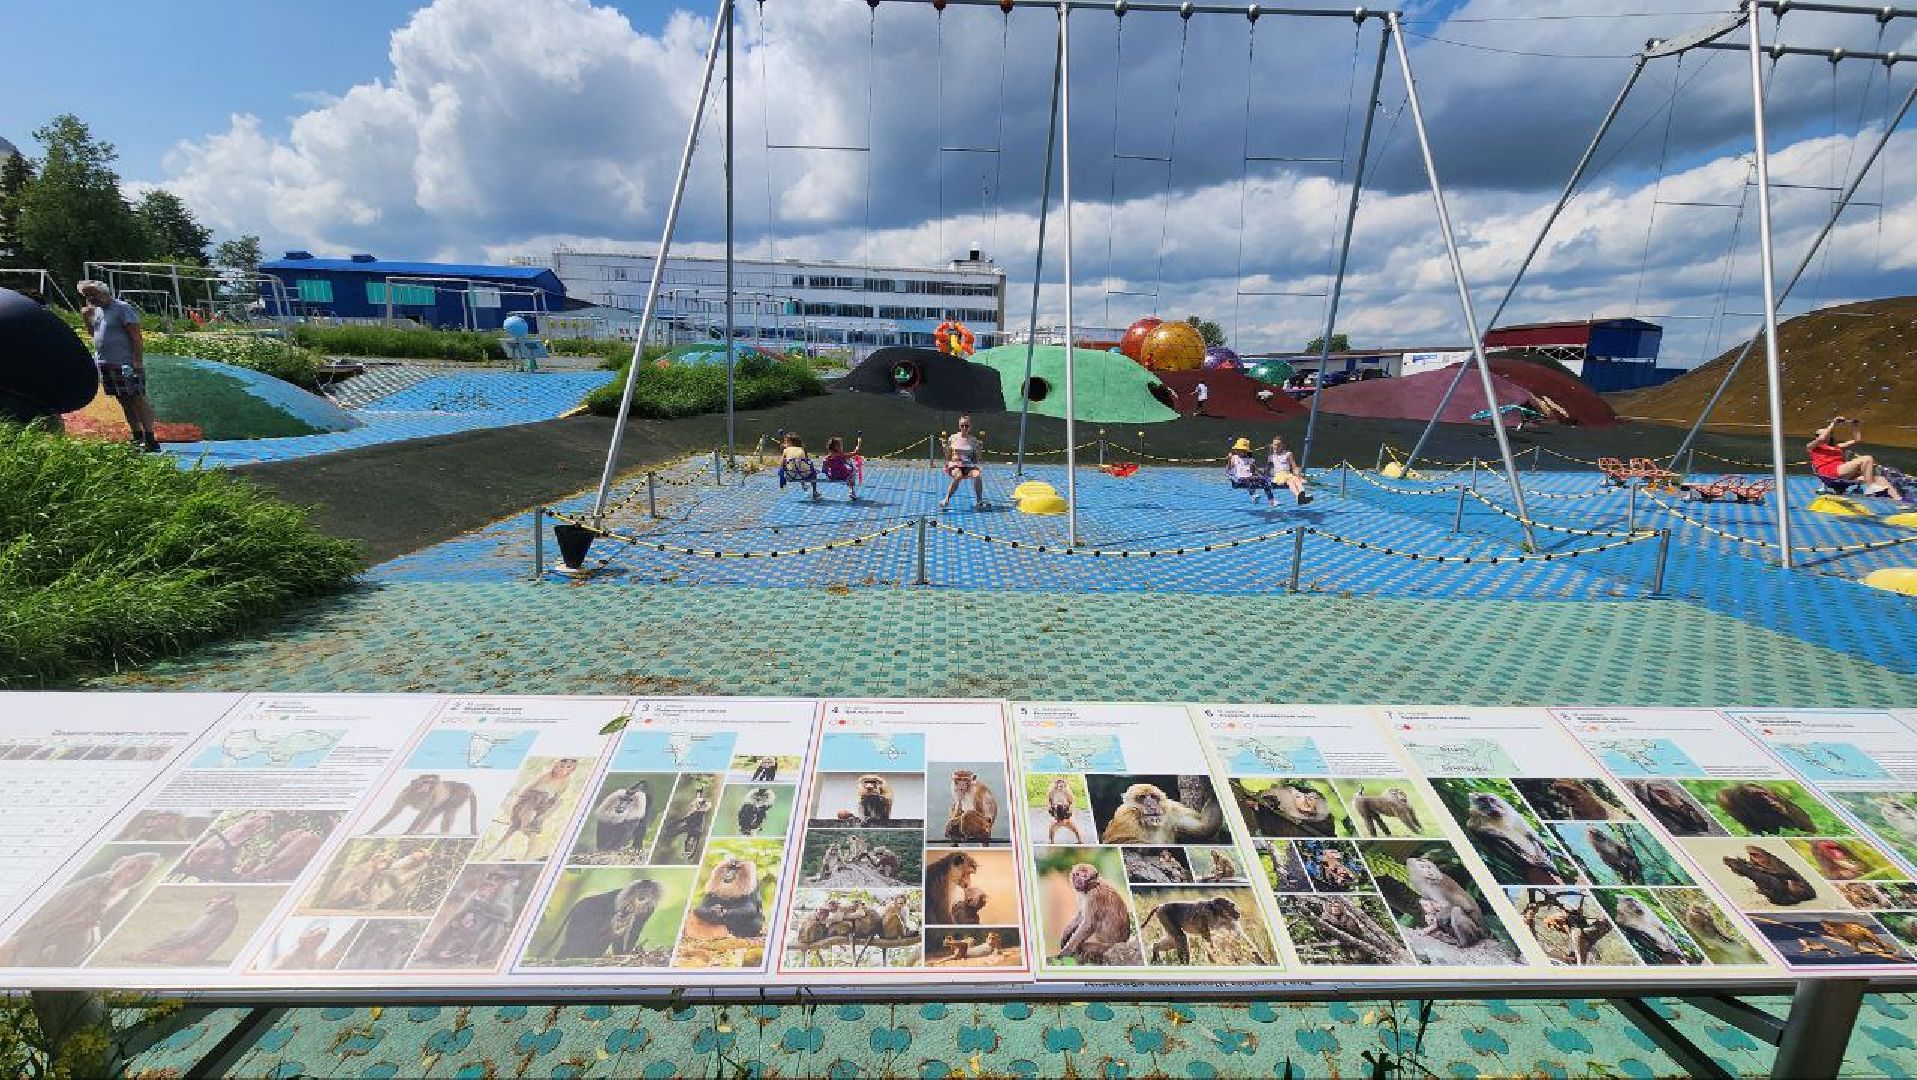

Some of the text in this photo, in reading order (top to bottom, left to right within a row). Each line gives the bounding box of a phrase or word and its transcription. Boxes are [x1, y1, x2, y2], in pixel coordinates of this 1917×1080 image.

[641, 703, 650, 712] 3
[831, 706, 839, 714] 4
[1020, 707, 1028, 715] 5
